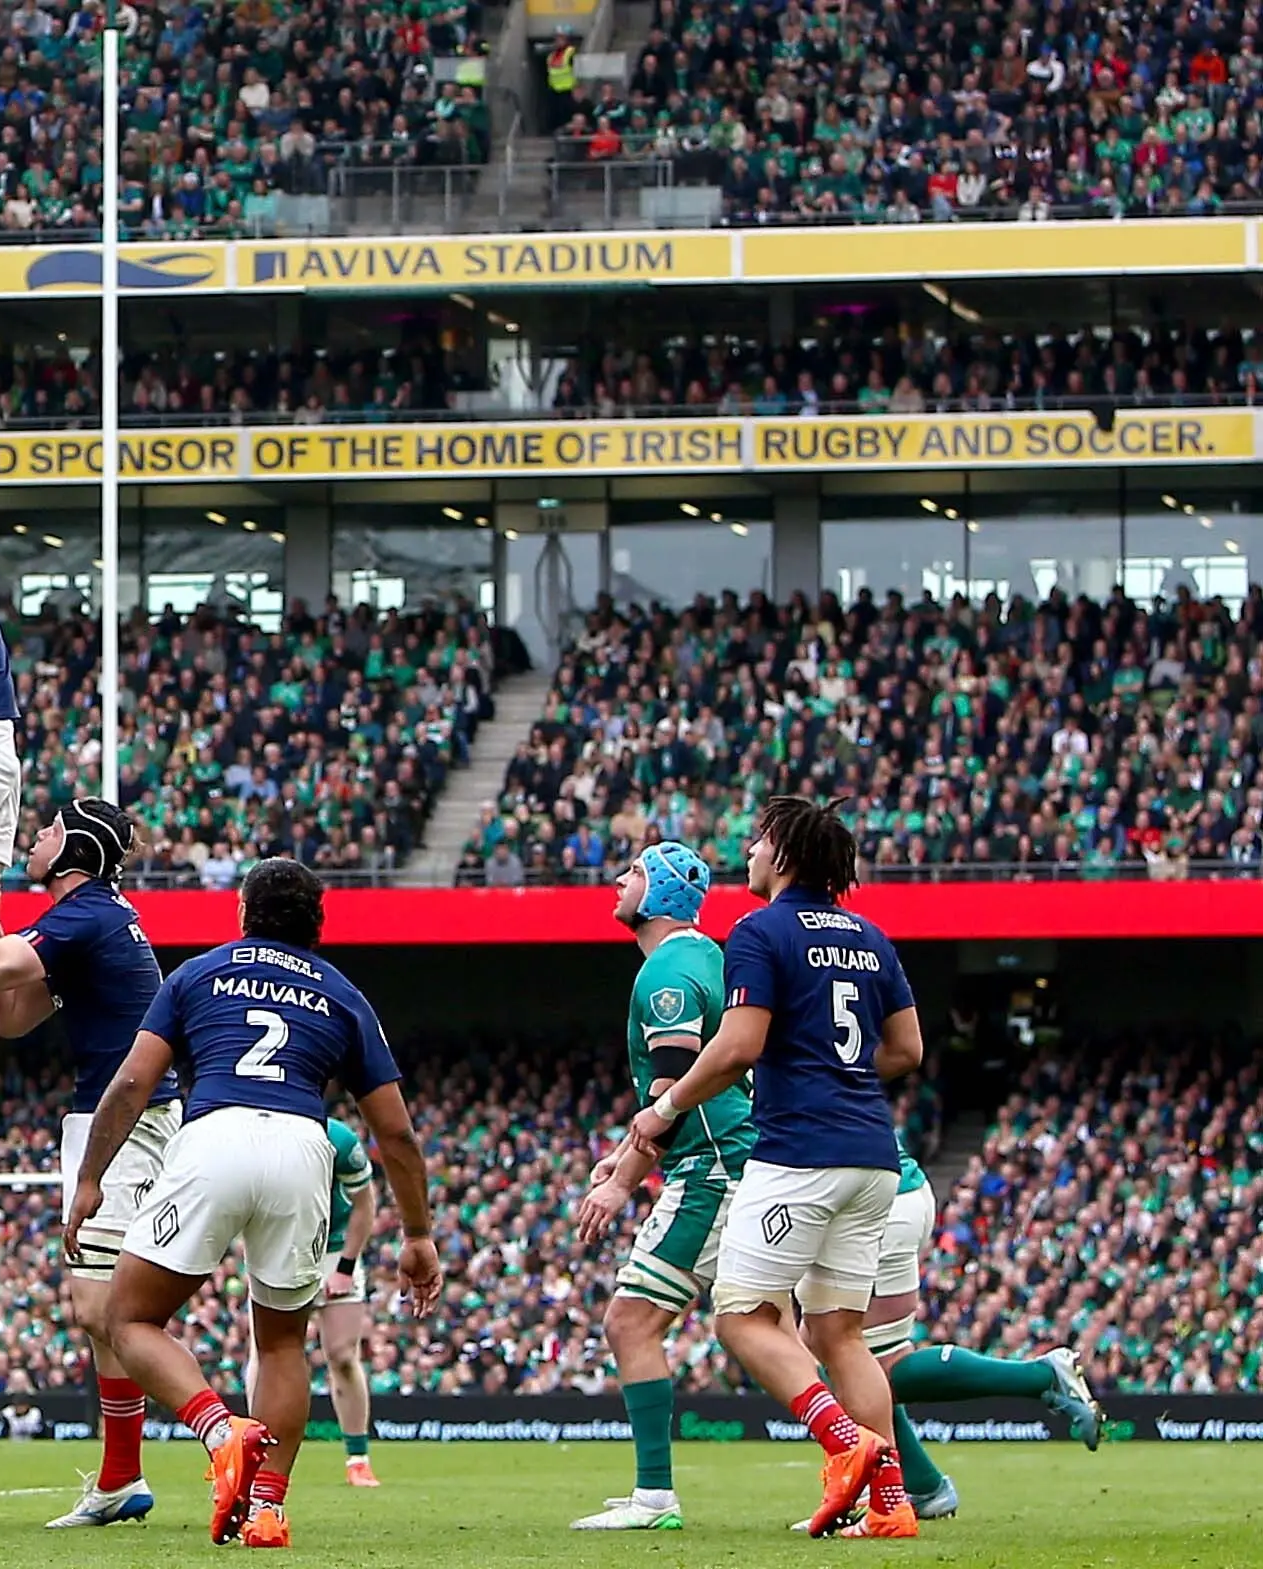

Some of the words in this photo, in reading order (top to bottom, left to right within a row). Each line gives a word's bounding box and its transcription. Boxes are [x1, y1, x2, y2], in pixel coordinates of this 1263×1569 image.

[299, 247, 442, 277] AVIVA
[464, 241, 674, 274] STADIUM
[30, 440, 234, 475] SPONSOR
[255, 437, 309, 469] OF
[320, 435, 403, 468] THE
[416, 433, 544, 466] HOME
[556, 431, 609, 464] OF
[622, 429, 742, 462] IRISH
[763, 425, 909, 459] RUGBY
[920, 422, 1013, 456] AND
[1025, 420, 1215, 455] SOCCER.
[212, 977, 330, 1017] MAUVAKA
[832, 980, 862, 1065] 5
[235, 1009, 289, 1082] 2
[374, 1419, 419, 1439] Your
[419, 1418, 440, 1439] AI
[441, 1418, 561, 1443] productivity
[1156, 1419, 1202, 1440] Your
[1202, 1418, 1224, 1440] AI
